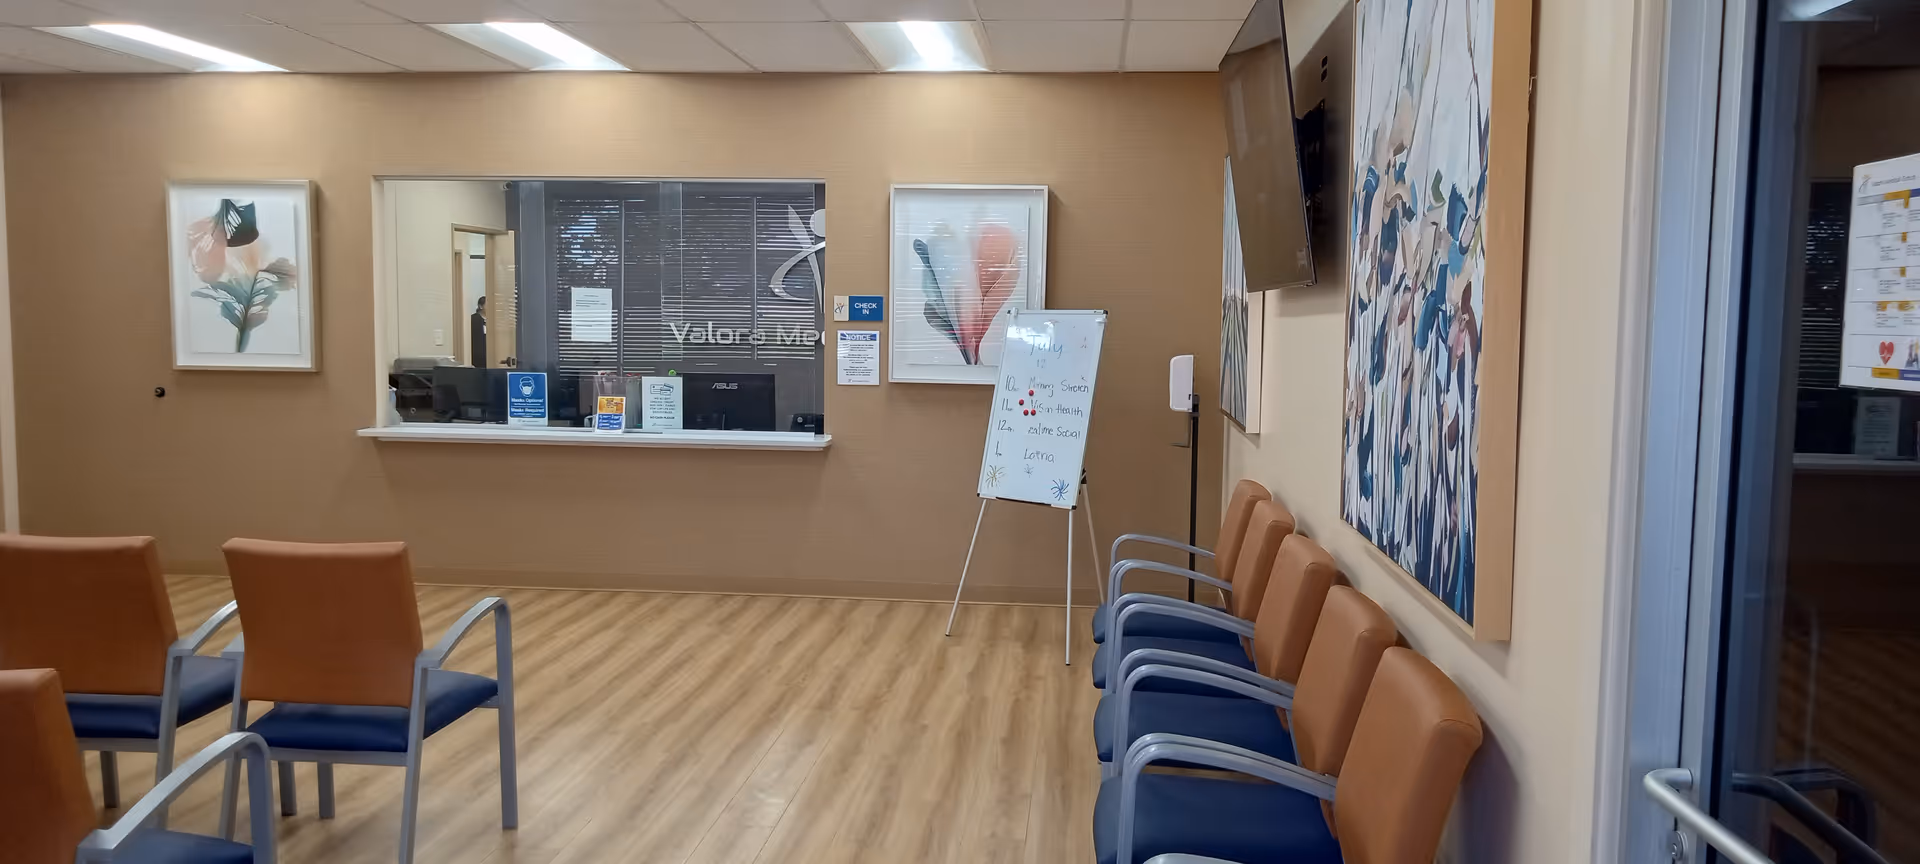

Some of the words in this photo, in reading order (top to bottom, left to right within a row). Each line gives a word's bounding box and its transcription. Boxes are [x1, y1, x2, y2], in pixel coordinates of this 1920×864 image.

[669, 321, 766, 345] Valora
[1026, 334, 1063, 360] July
[711, 382, 739, 390] ASUS
